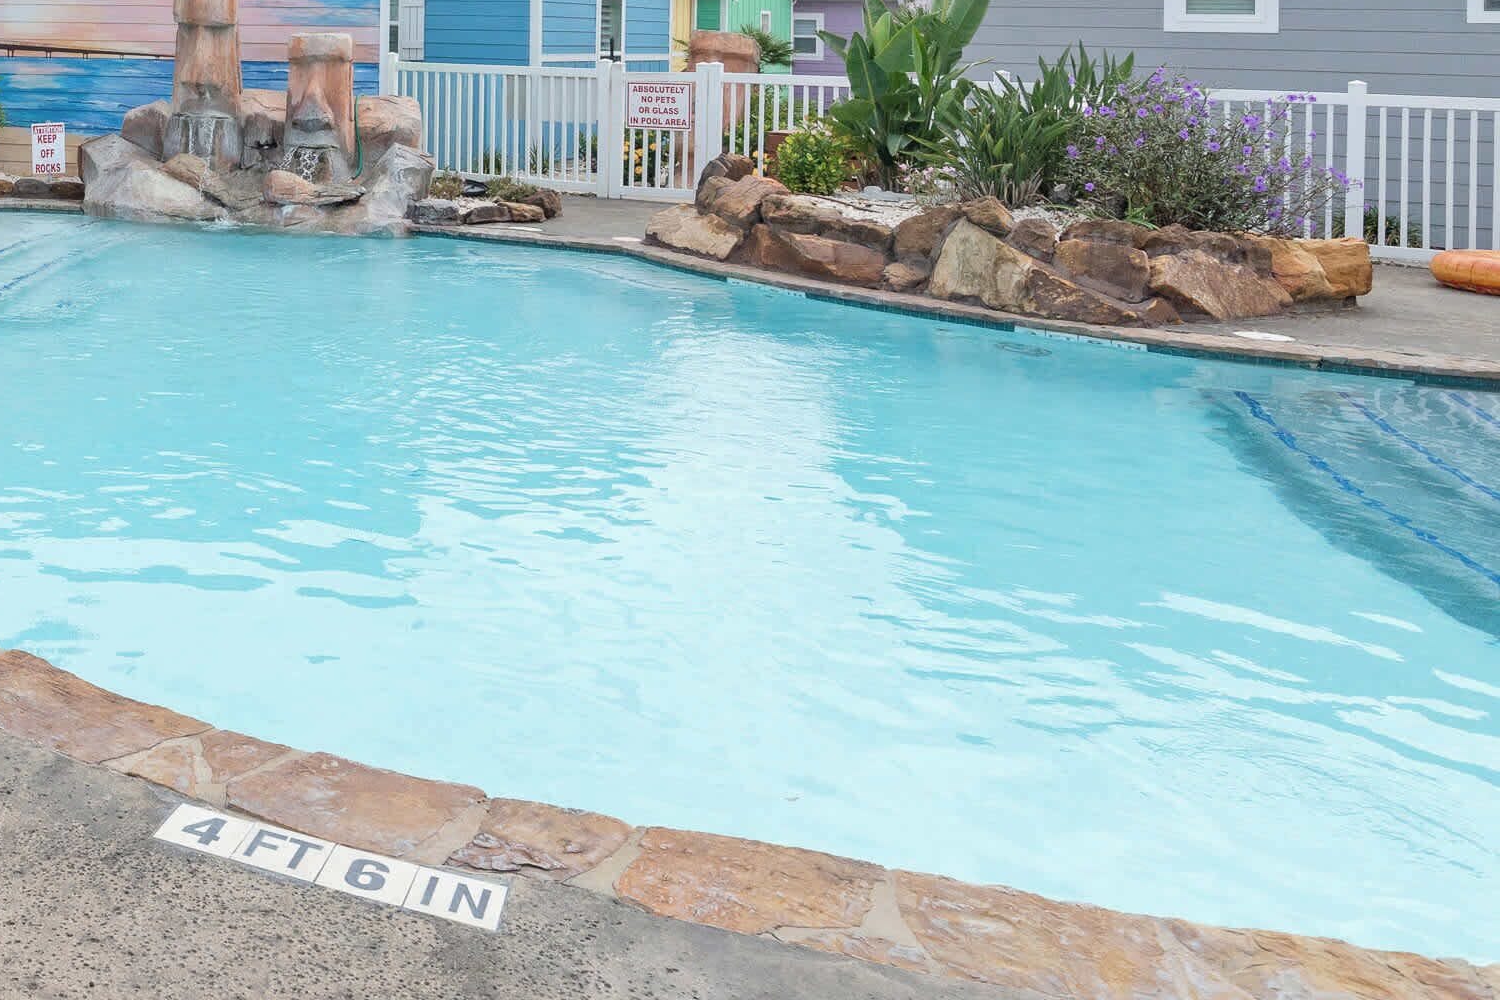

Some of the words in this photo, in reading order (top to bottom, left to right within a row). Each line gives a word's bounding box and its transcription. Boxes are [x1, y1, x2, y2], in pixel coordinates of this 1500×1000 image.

[632, 85, 686, 94] ABSOLUTELY
[641, 95, 653, 103] NO
[655, 96, 677, 104] PETS
[638, 106, 650, 114] OR
[652, 107, 680, 115] GLASS
[630, 116, 639, 124] IN
[641, 117, 663, 125] POOL
[665, 118, 687, 126] AREA
[37, 134, 57, 144] KEEP
[40, 149, 55, 159] OFF
[35, 163, 61, 173] ROCKS
[181, 816, 228, 847] 4
[242, 828, 324, 870] FT
[344, 858, 391, 892] 6
[419, 876, 493, 920] IN
